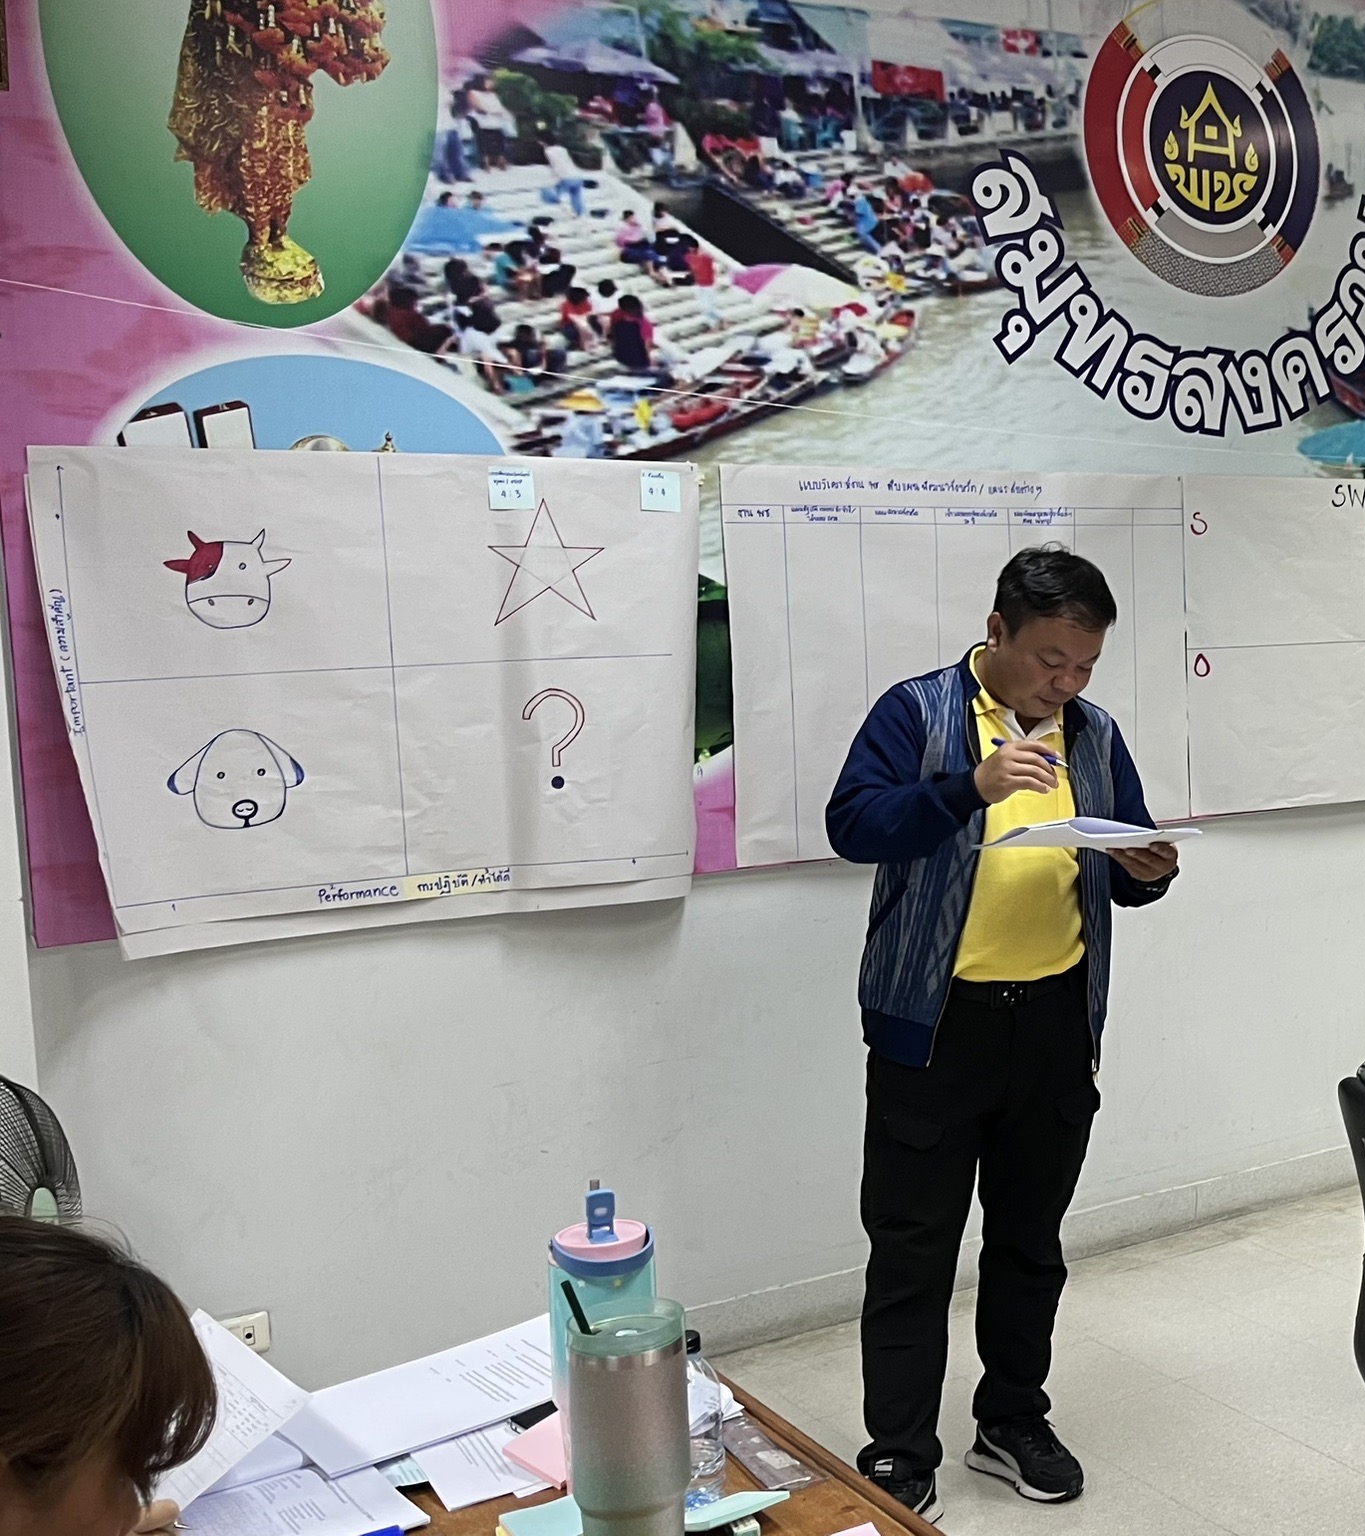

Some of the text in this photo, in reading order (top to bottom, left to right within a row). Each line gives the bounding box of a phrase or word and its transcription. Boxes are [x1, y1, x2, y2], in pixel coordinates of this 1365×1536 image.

[1189, 511, 1208, 537] S
[1192, 653, 1211, 679] O
[60, 664, 86, 736] Important
[317, 884, 400, 904] Performance
